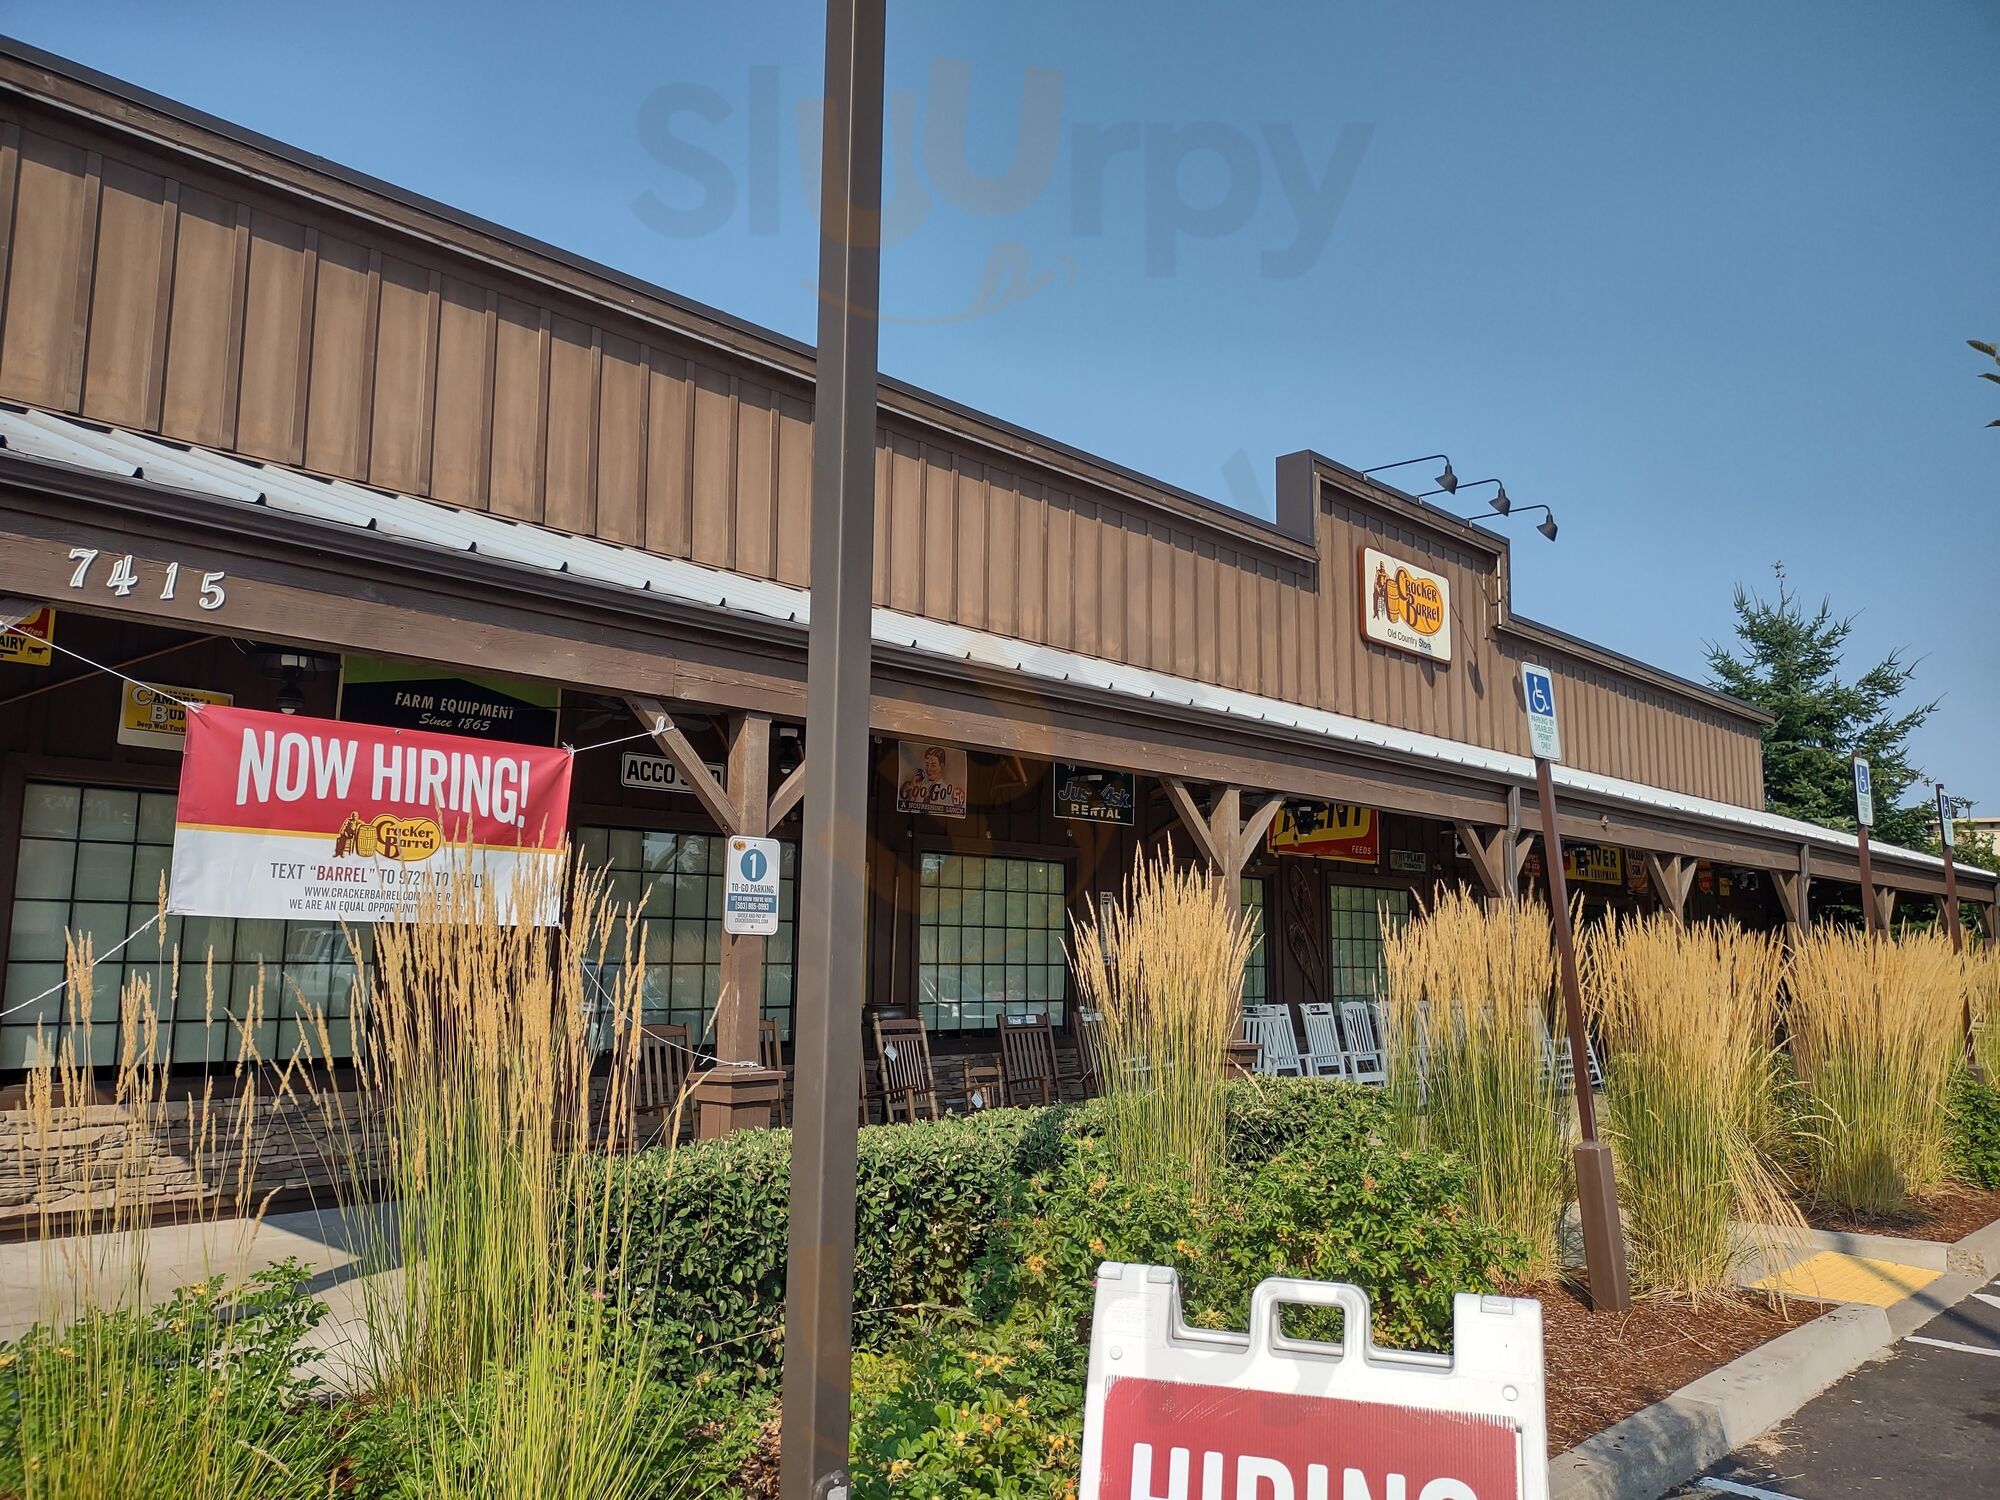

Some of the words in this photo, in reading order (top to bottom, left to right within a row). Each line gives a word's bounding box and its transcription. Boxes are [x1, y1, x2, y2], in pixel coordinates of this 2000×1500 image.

[69, 549, 225, 609] 7415
[1396, 570, 1437, 603] Cracker
[1406, 593, 1439, 628] Barrel
[1387, 629, 1397, 639] Old
[1397, 632, 1418, 647] Country
[1418, 638, 1432, 650] Store
[394, 692, 434, 710] FARM
[440, 698, 514, 720] EQUIPMENT
[136, 721, 153, 730] Deep
[154, 722, 168, 730] Well
[418, 713, 453, 727] Since
[458, 718, 491, 731] 1865
[235, 728, 358, 806] NOW
[371, 743, 531, 828] HIRING!
[626, 760, 675, 784] ACCO
[1058, 781, 1093, 803] Jus
[1071, 803, 1121, 819] RENTAL
[375, 820, 434, 846] Cracker
[384, 836, 434, 858] Barrel
[1351, 845, 1372, 856] FEEDS
[270, 863, 305, 879] TEXT
[380, 868, 395, 884] TO
[749, 853, 757, 878] 1
[731, 883, 749, 893] TO-GO
[750, 884, 774, 894] PARKING
[289, 899, 303, 910] WE
[305, 899, 322, 910] ARE
[325, 900, 337, 911] AN
[339, 901, 365, 912] EQUAL
[368, 902, 421, 913] OPPORTUNIT
